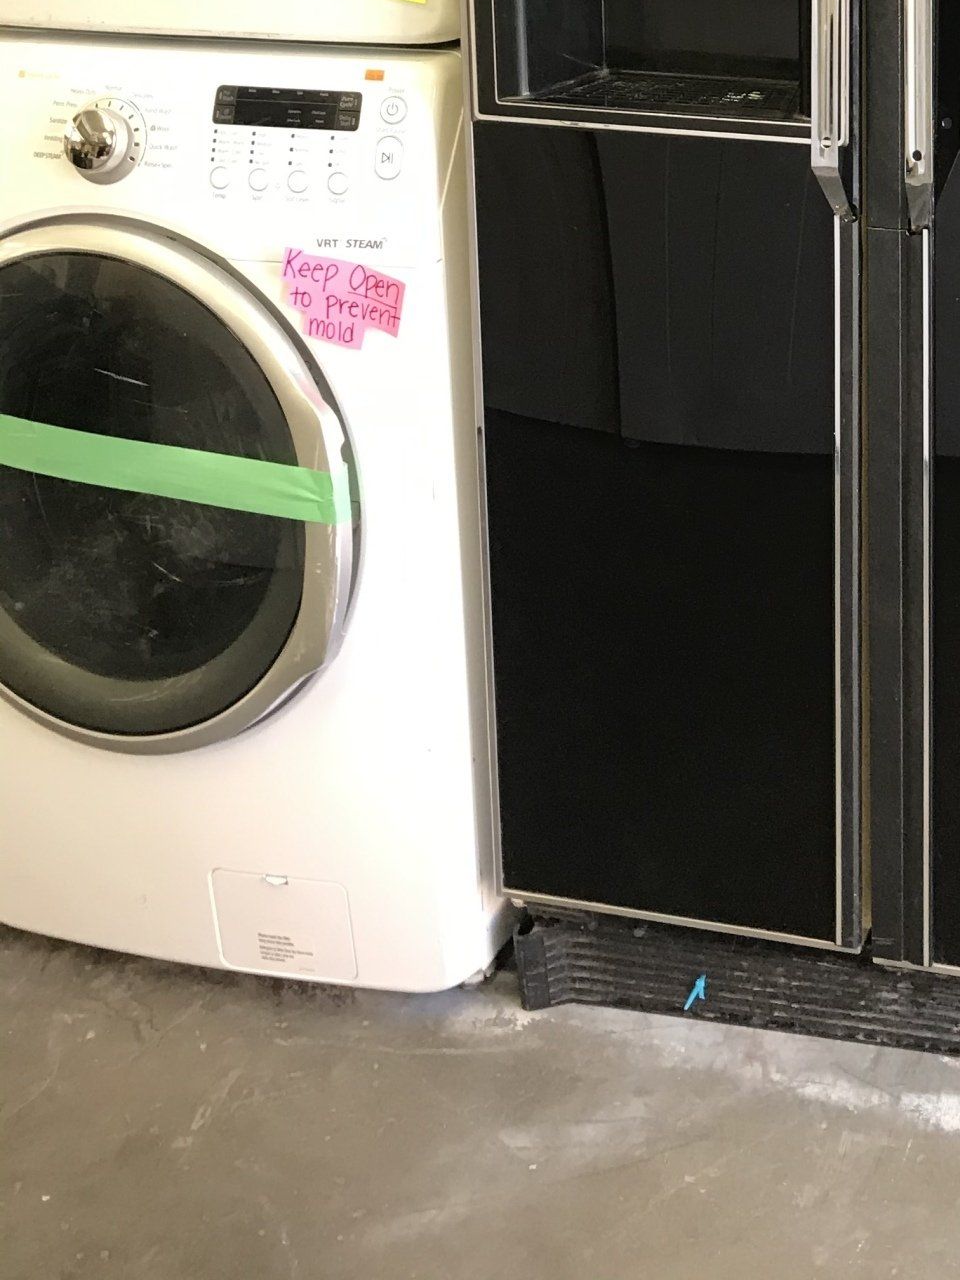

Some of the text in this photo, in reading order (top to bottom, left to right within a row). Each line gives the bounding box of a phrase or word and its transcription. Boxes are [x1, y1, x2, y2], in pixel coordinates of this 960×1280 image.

[316, 238, 384, 249] VRT STEAM
[283, 248, 400, 305] Keep Open
[290, 286, 312, 308] to
[308, 317, 355, 344] mold
